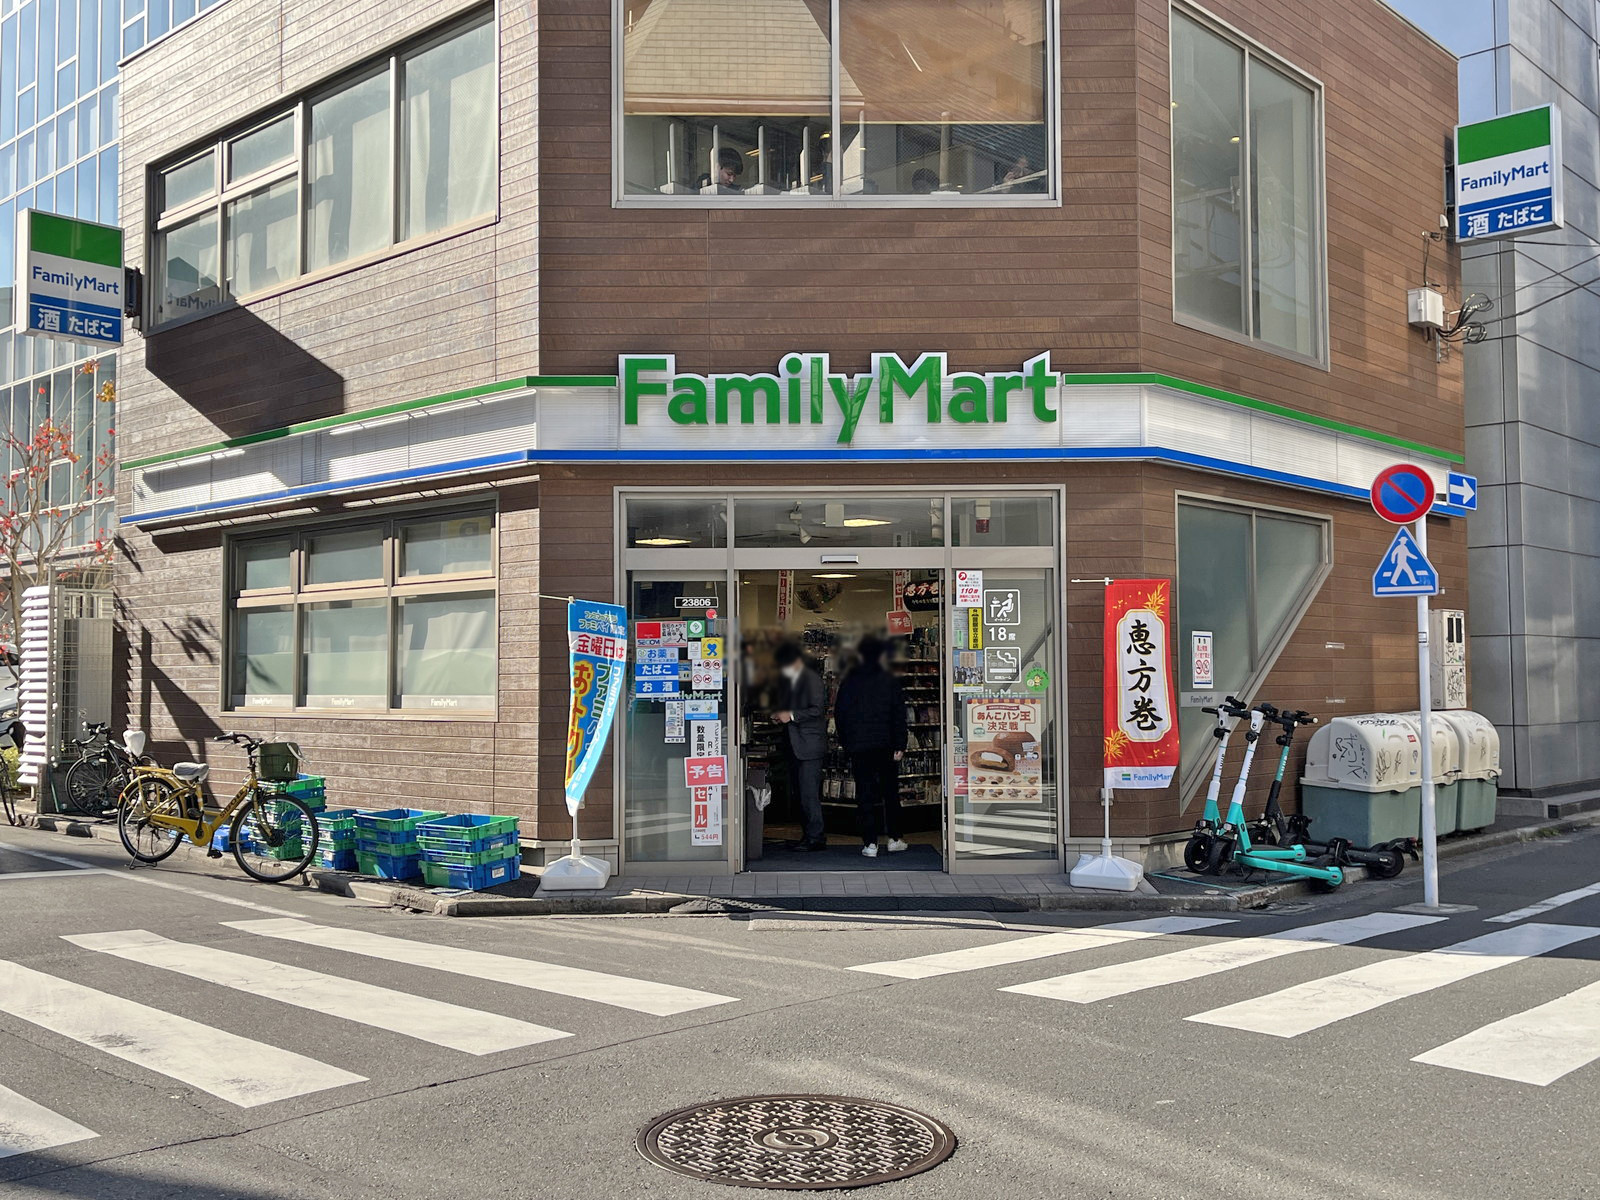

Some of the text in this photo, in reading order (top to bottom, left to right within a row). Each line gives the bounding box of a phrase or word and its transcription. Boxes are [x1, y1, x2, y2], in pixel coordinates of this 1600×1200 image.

[1461, 161, 1549, 191] FamilyMart
[1467, 205, 1545, 236] 酒 たばこ
[32, 266, 119, 295] FamilyMart
[38, 307, 114, 338] 酒 たばこ
[623, 355, 1058, 444] FamilyMart
[682, 598, 711, 607] 23806
[988, 627, 1016, 641] 18席
[576, 634, 624, 659] 金曜日は
[647, 649, 667, 658] お薬
[642, 665, 672, 675] たばこ
[1126, 619, 1163, 731] 恵方巻
[430, 698, 458, 707] FamilyMart
[977, 711, 1031, 721] あんこパン王
[987, 721, 1019, 731] 決定戦
[689, 764, 723, 779] 予告
